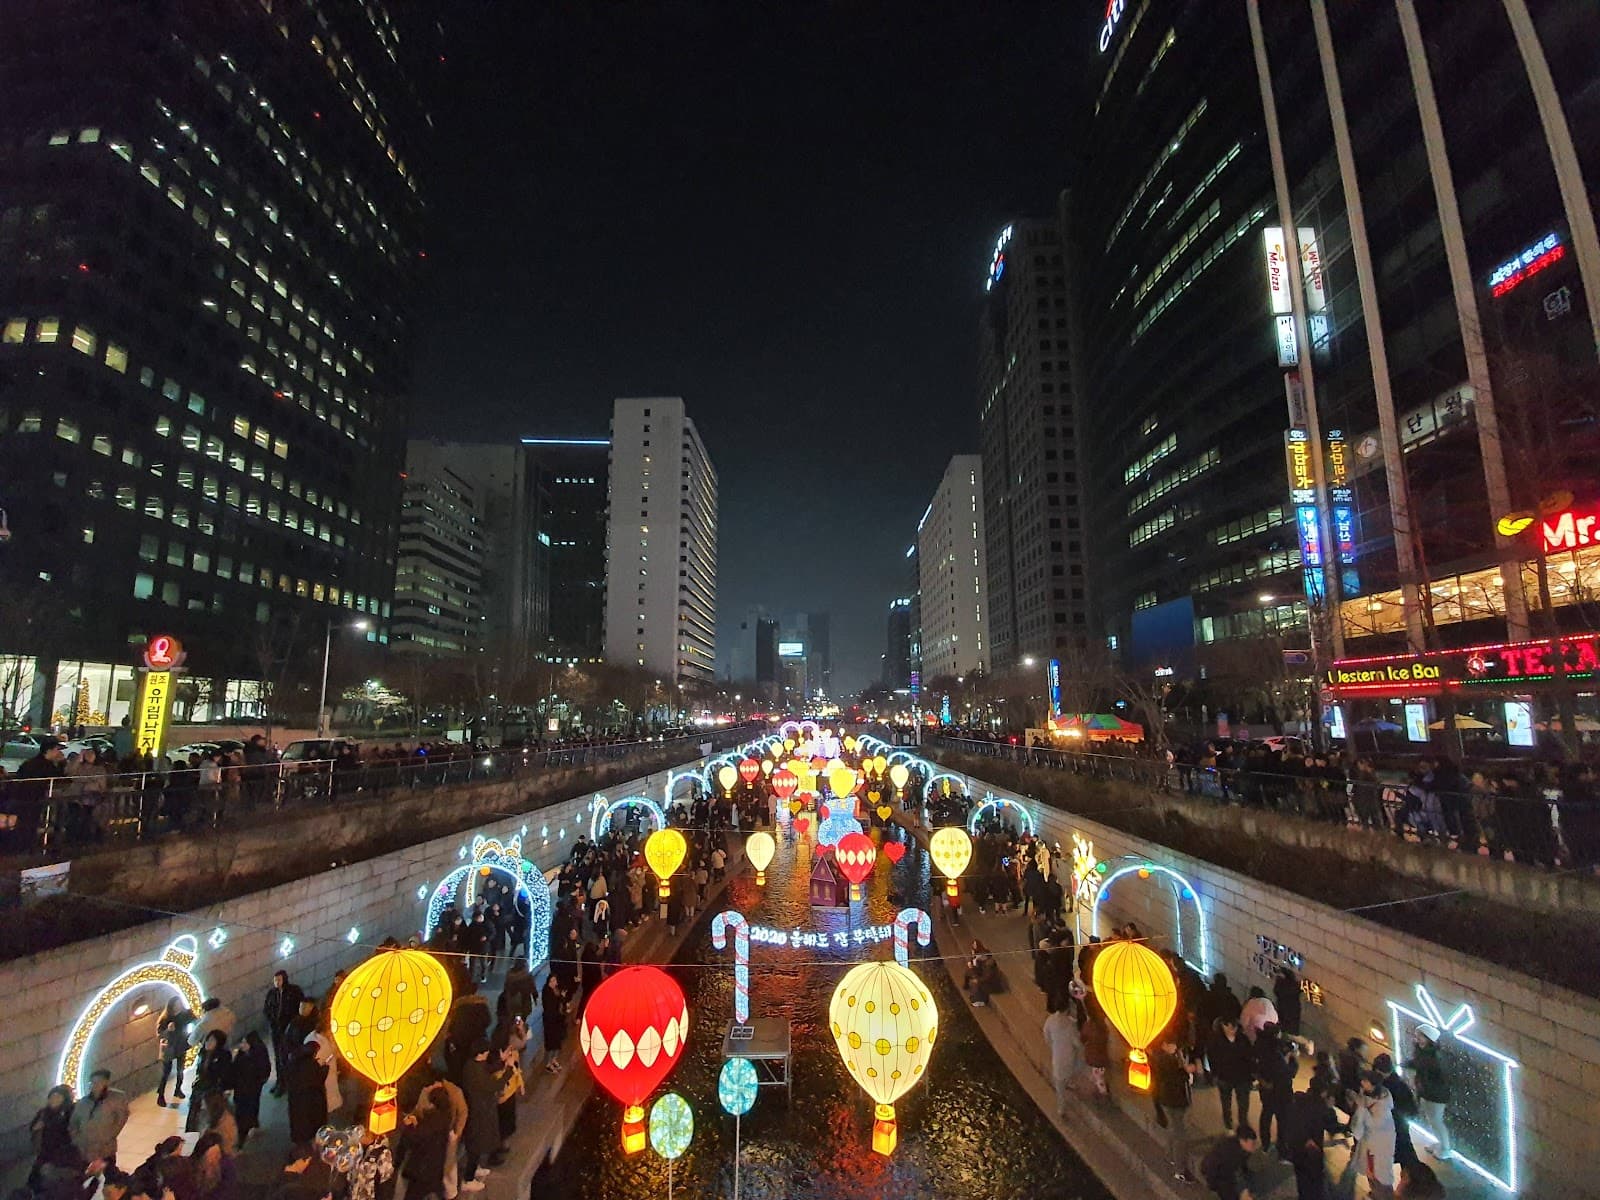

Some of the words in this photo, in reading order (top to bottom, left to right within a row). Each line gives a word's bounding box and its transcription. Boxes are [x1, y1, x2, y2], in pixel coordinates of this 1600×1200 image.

[149, 675, 167, 685] 원조
[1387, 665, 1409, 681] Ice
[142, 688, 163, 750] 유림낙지
[750, 926, 788, 945] 2020
[790, 928, 829, 948] 올해도
[833, 931, 849, 948] 잘
[853, 924, 892, 944] 부탁해
[1300, 979, 1324, 1006] 서울
